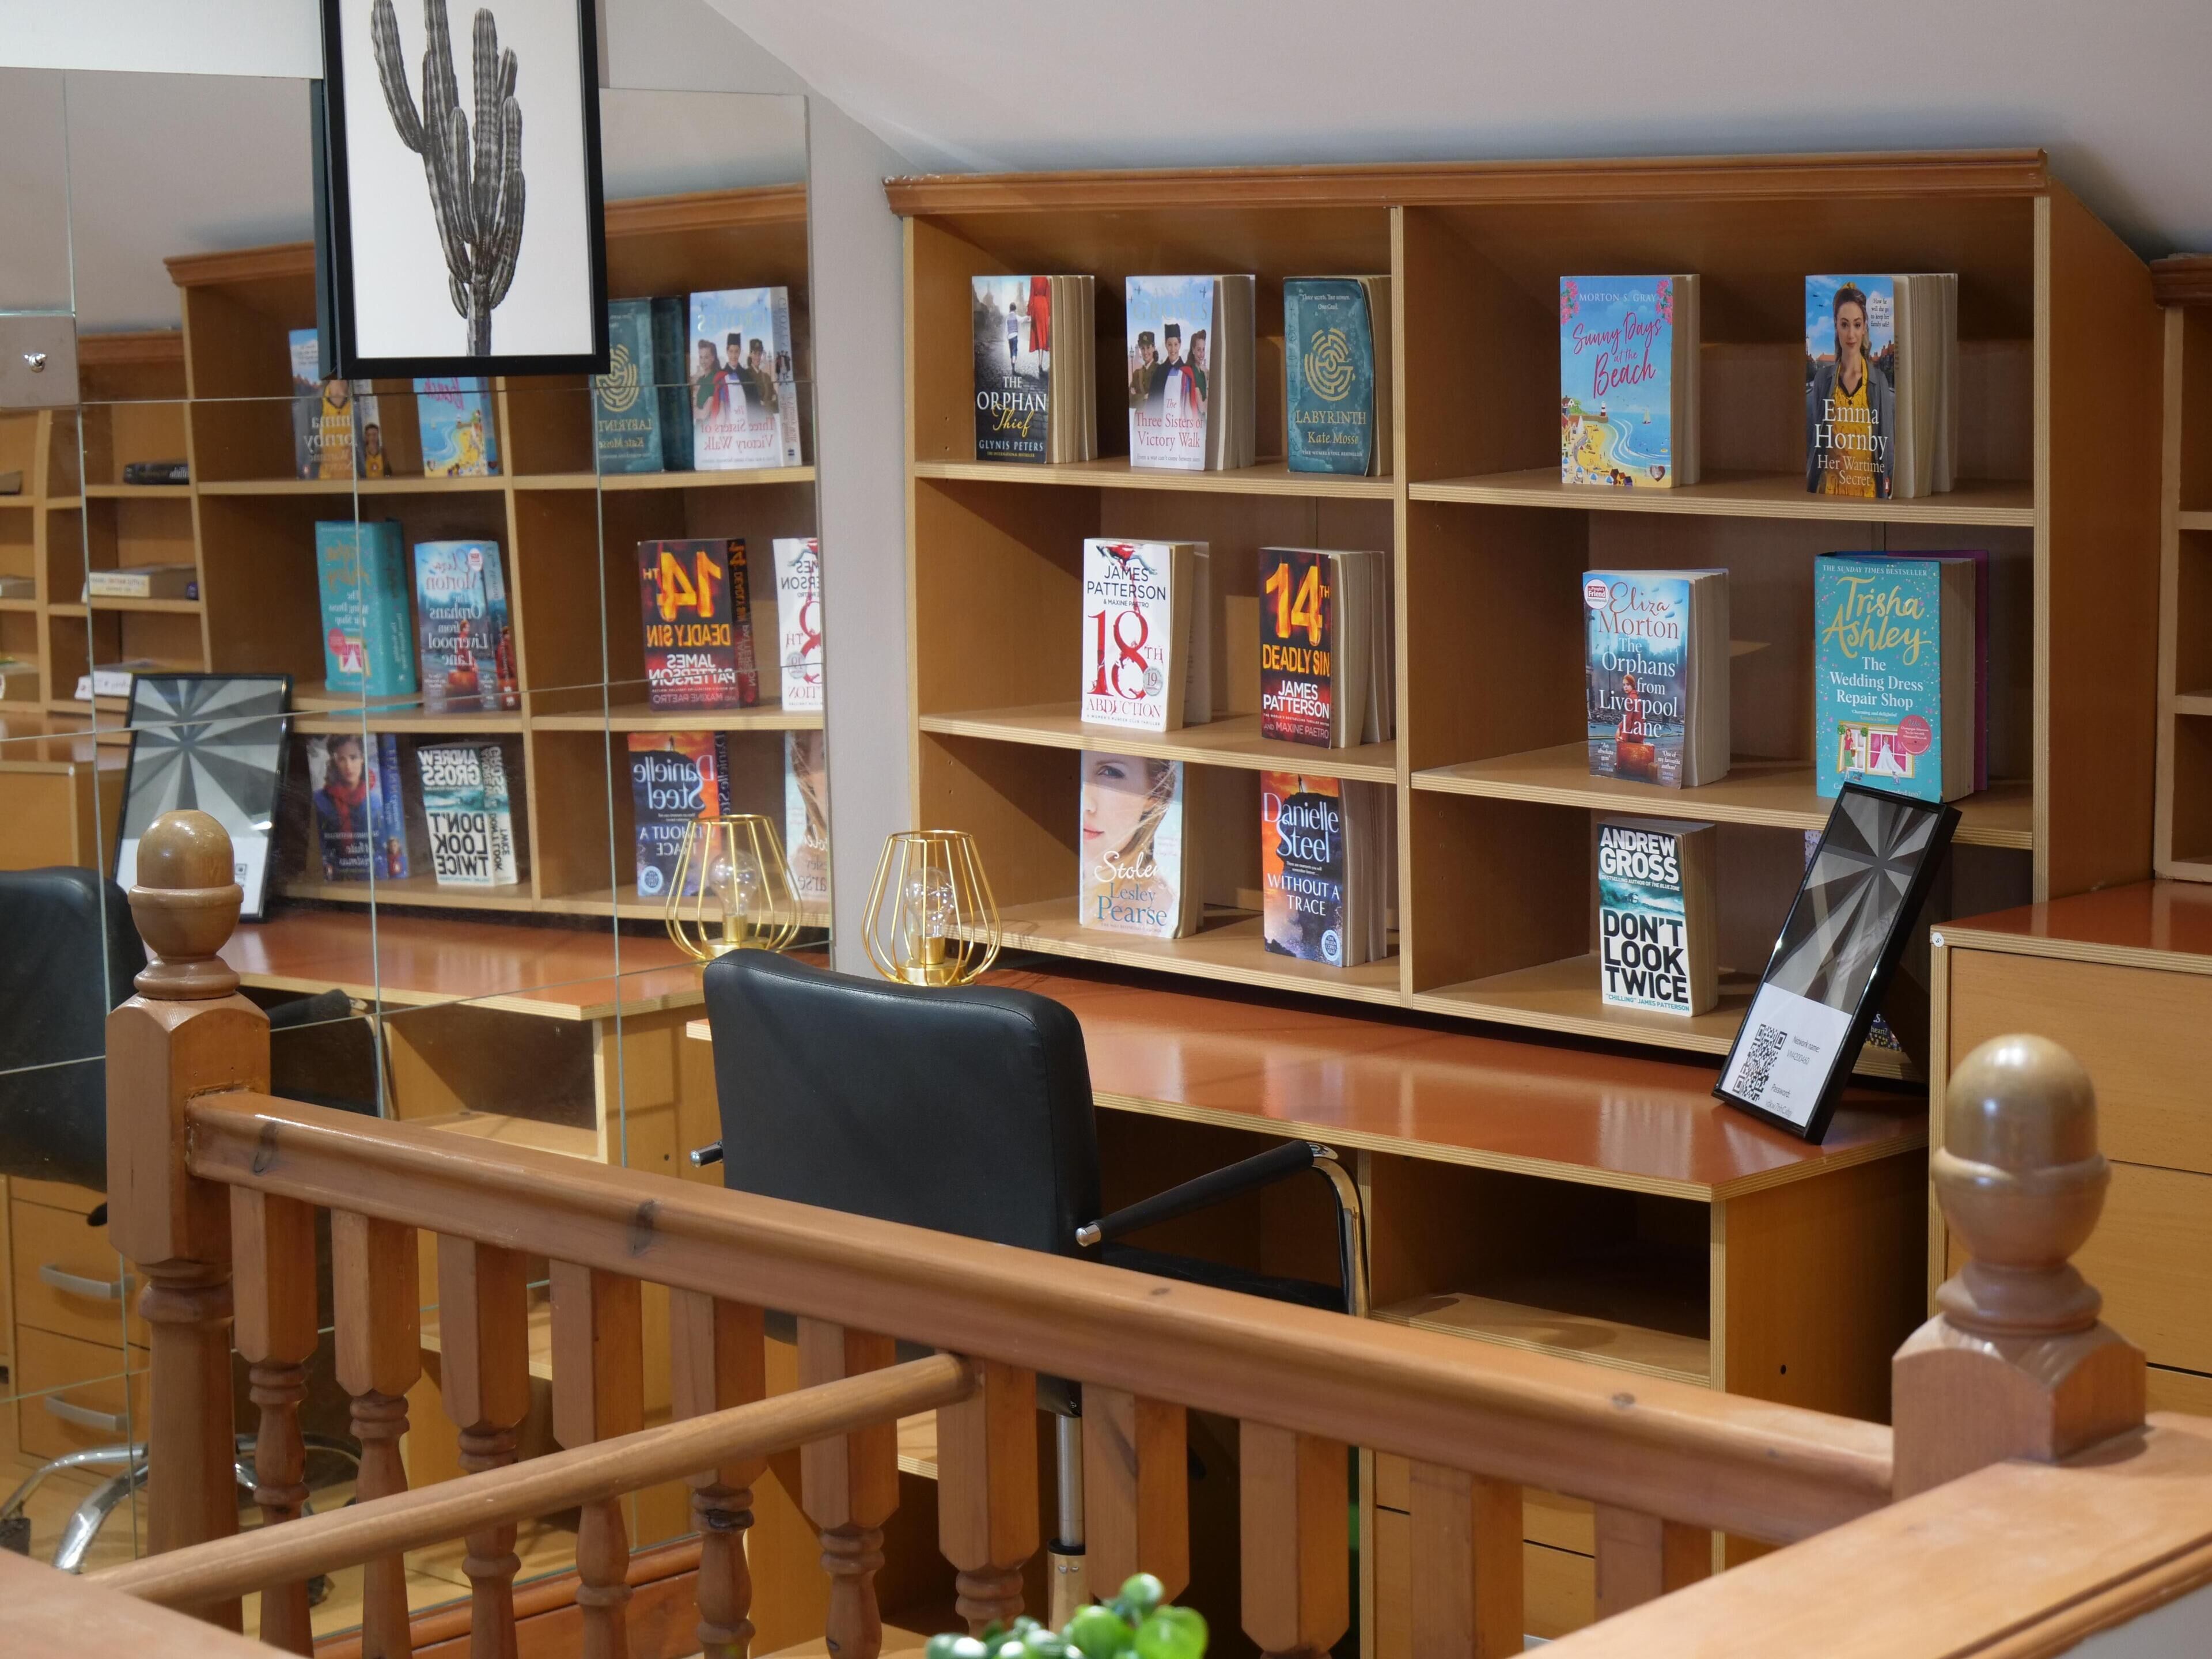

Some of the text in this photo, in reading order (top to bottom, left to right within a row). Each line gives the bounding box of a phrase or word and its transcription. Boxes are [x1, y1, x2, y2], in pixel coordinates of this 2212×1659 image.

[1579, 293, 1619, 302] MORTON
[1633, 293, 1657, 302] GRAY
[1572, 311, 1662, 355] Sunny Days
[1614, 349, 1639, 363] at the
[1003, 376, 1022, 388] THE
[1593, 349, 1657, 399] Beach
[977, 391, 1047, 411] ORPHAN
[1166, 398, 1177, 408] The
[992, 403, 1035, 437] Thief
[1135, 412, 1162, 427] Three
[1165, 413, 1194, 429] Sisters
[1296, 410, 1366, 425] LABYRINTH
[1822, 399, 1880, 425] Emma
[979, 440, 1043, 452] GLYNIS PETERS
[1138, 431, 1200, 452] Victory Walk
[1308, 431, 1359, 444] Kate Mosse
[1815, 424, 1888, 460] Hornby
[1817, 454, 1885, 473] Her Wartime
[1839, 469, 1870, 486] Secret
[1104, 565, 1149, 582] JAMES
[1886, 568, 1927, 576] BESTSELLER
[1087, 581, 1166, 600] PATTERSON
[1609, 582, 1670, 616] Eliza
[1836, 575, 1925, 621] Trisha
[1599, 610, 1679, 639] Morton
[1821, 604, 1932, 665] Ashley
[1619, 638, 1642, 653] The
[1262, 644, 1330, 677] DEADLY SIN
[1602, 651, 1676, 677] Orphans
[1862, 656, 1887, 671] The
[1147, 672, 1157, 686] 19
[1637, 677, 1665, 695] from
[1830, 671, 1923, 691] Wedding Dress
[1278, 680, 1319, 700] JAMES
[1836, 689, 1914, 711] Repair Shop
[1087, 698, 1161, 718] ABDUCTION
[1263, 694, 1330, 719] PATTERSON
[1599, 690, 1677, 719] Liverpool
[1276, 721, 1304, 734] MAXINE
[1305, 726, 1329, 739] PAETRO
[1622, 714, 1662, 738] Lane
[1264, 793, 1339, 833] Danielle
[1276, 819, 1330, 863] Steel
[1600, 827, 1676, 857] ANDREW
[1600, 847, 1679, 884] GROSS
[1267, 873, 1340, 900] WITHOUT A
[1601, 874, 1628, 883] BESTSELLING
[1110, 882, 1156, 908] Lesley
[1286, 895, 1326, 916] TRACE
[1097, 895, 1167, 926] Pearse
[1603, 908, 1683, 946] DON'T
[1604, 937, 1686, 976] LOOK
[1605, 965, 1688, 1003] TWICE
[1638, 998, 1656, 1006] JAMES
[1657, 1001, 1690, 1012] PATTERSON
[1870, 1025, 1888, 1035] heart?
